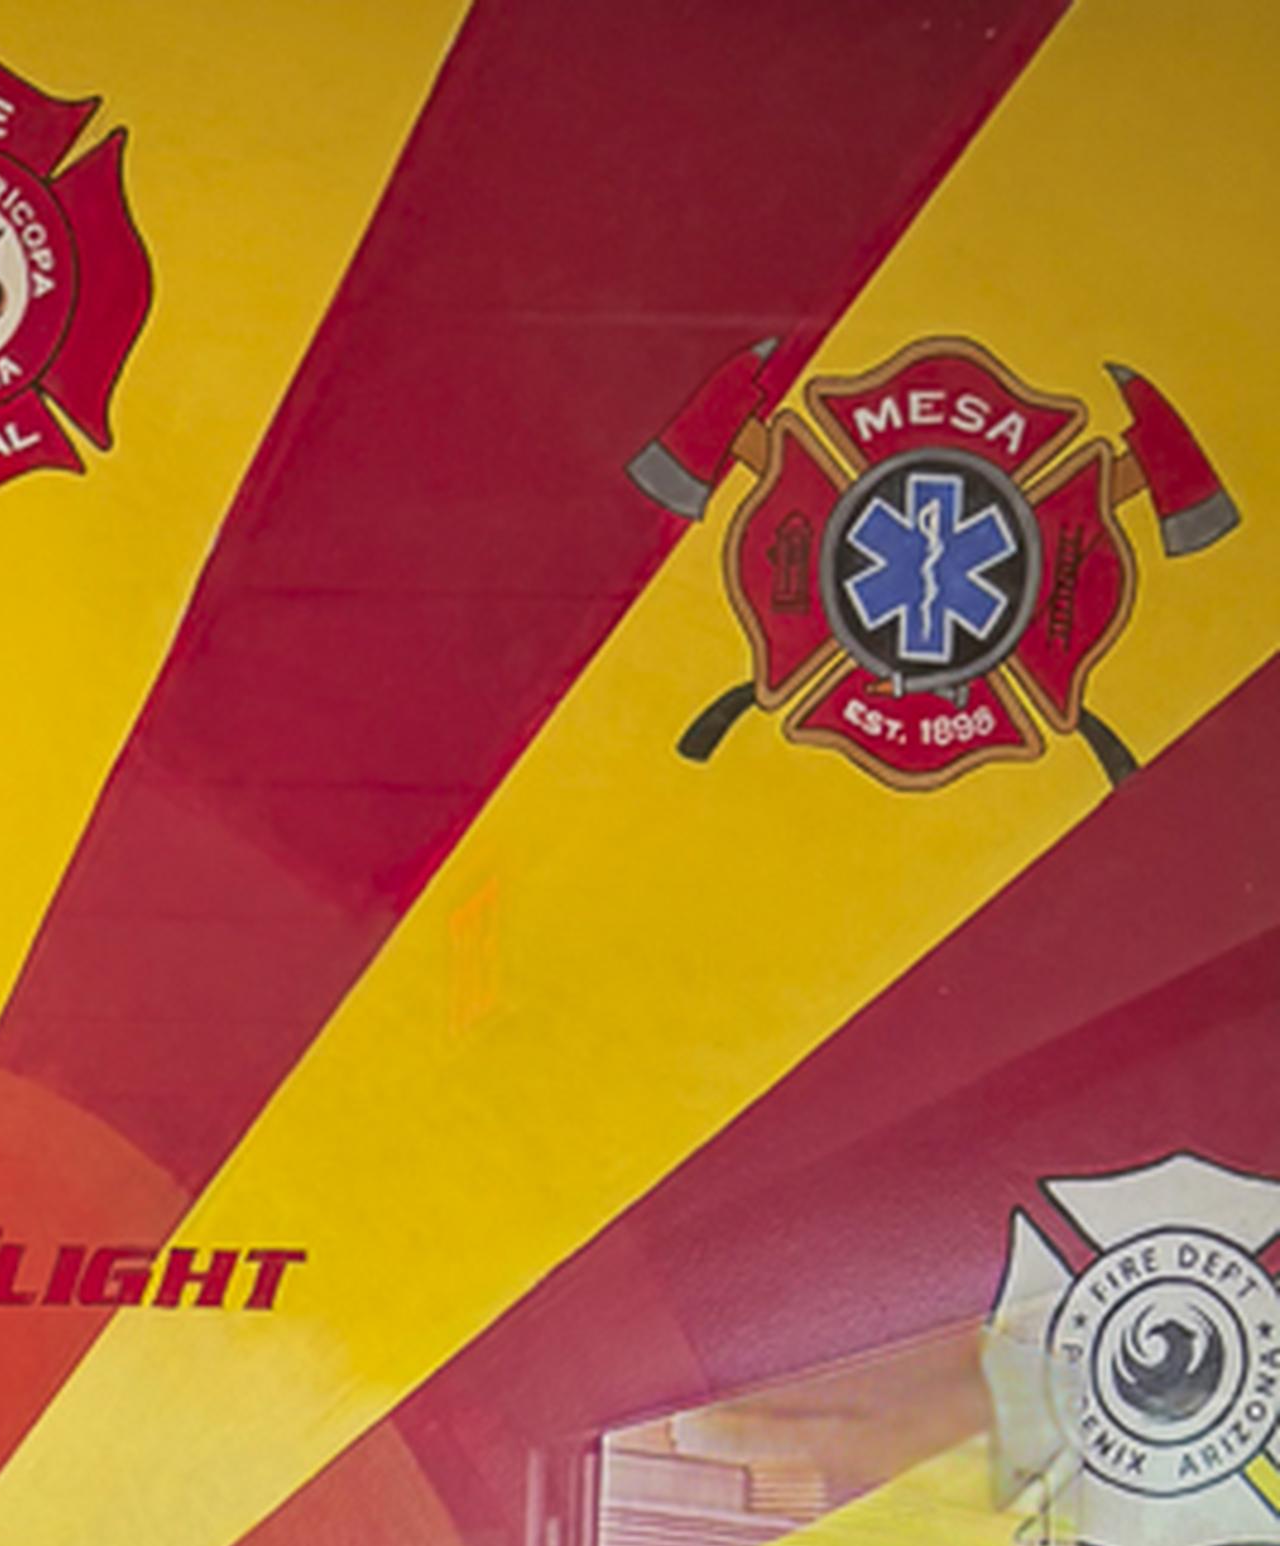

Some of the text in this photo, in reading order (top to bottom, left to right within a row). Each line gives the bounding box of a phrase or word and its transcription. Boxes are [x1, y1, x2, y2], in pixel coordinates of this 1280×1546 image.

[853, 389, 1033, 455] MESA
[842, 698, 908, 746] EST.
[1090, 1242, 1261, 1303] FIRE DEPT
